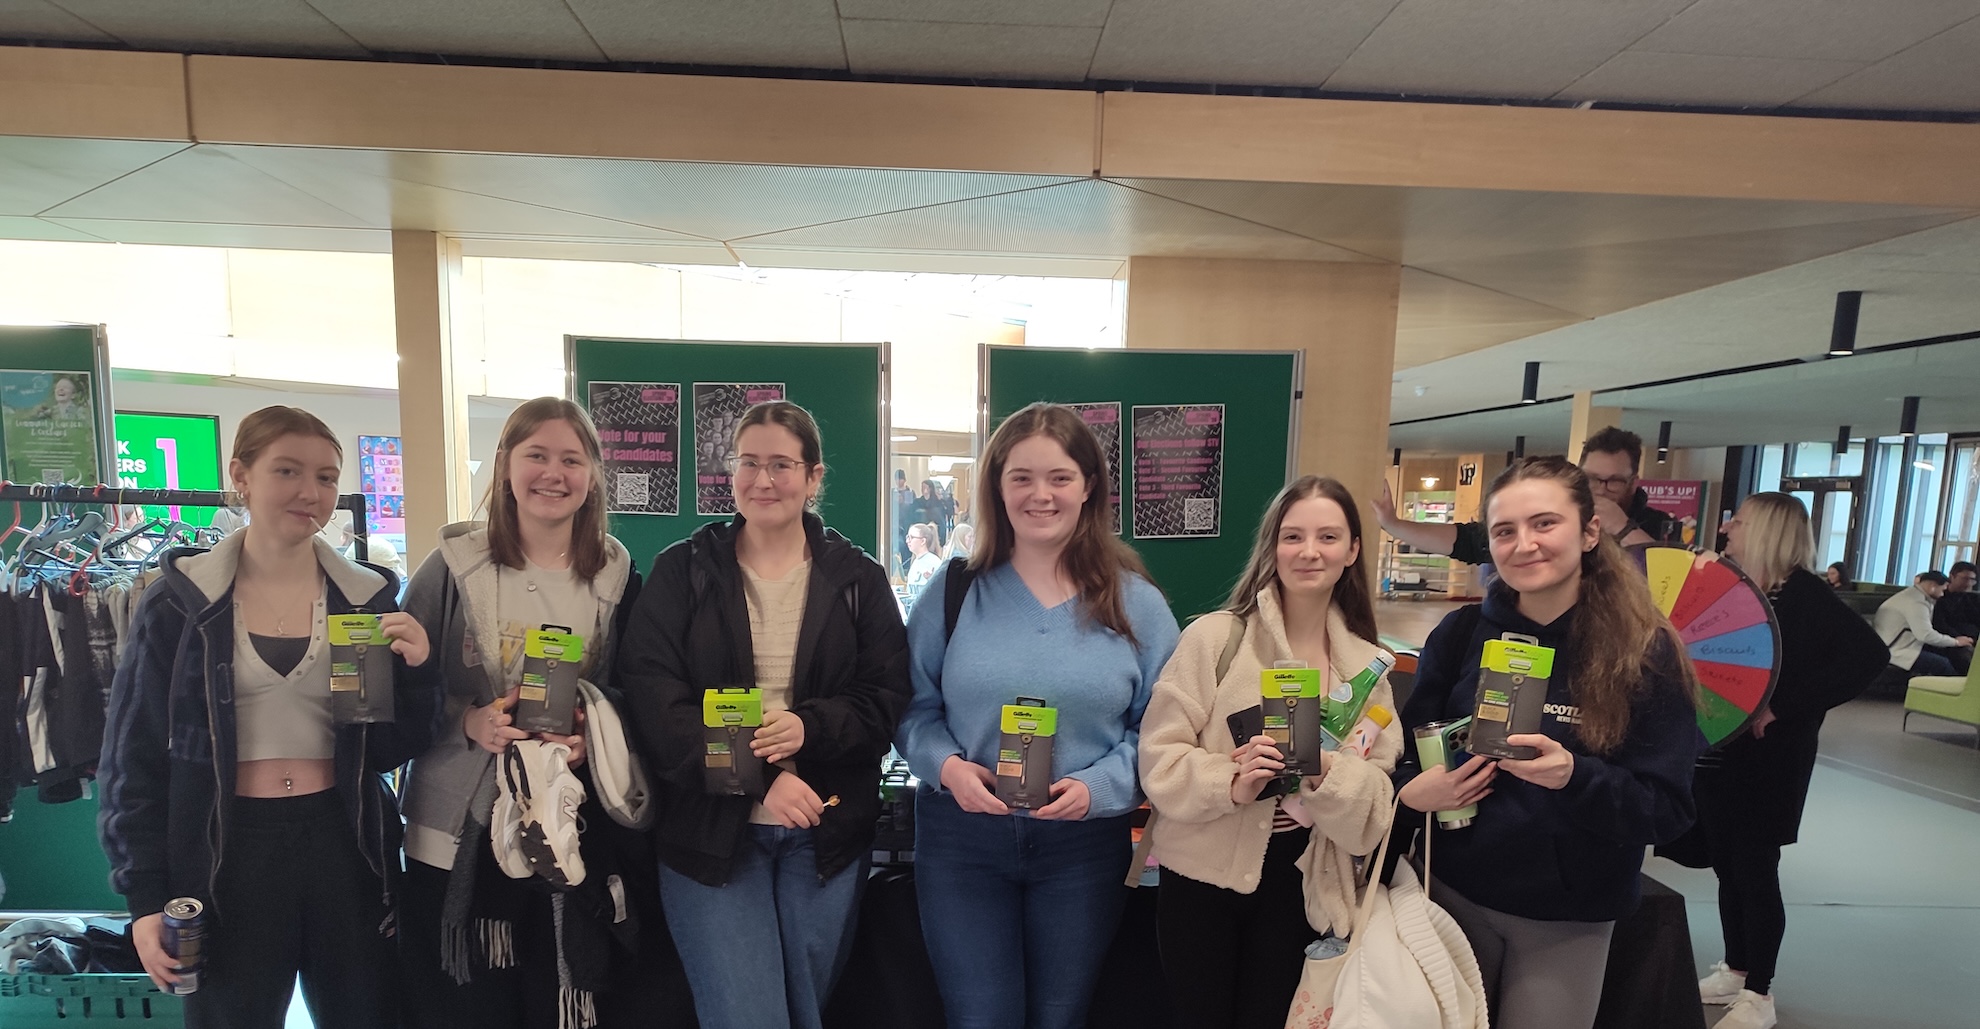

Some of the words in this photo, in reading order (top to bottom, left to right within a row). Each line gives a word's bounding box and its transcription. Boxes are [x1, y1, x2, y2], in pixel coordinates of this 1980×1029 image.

[598, 429, 621, 442] Vote
[624, 430, 639, 442] for
[641, 431, 667, 444] your
[117, 440, 131, 455] K
[613, 448, 673, 462] candidates
[117, 458, 147, 473] ERS
[118, 476, 139, 489] ON
[699, 475, 714, 484] Vote
[716, 475, 726, 484] for
[1641, 486, 1675, 496] RUB'S
[1677, 486, 1696, 496] UP!
[1543, 703, 1585, 717] SCOTL
